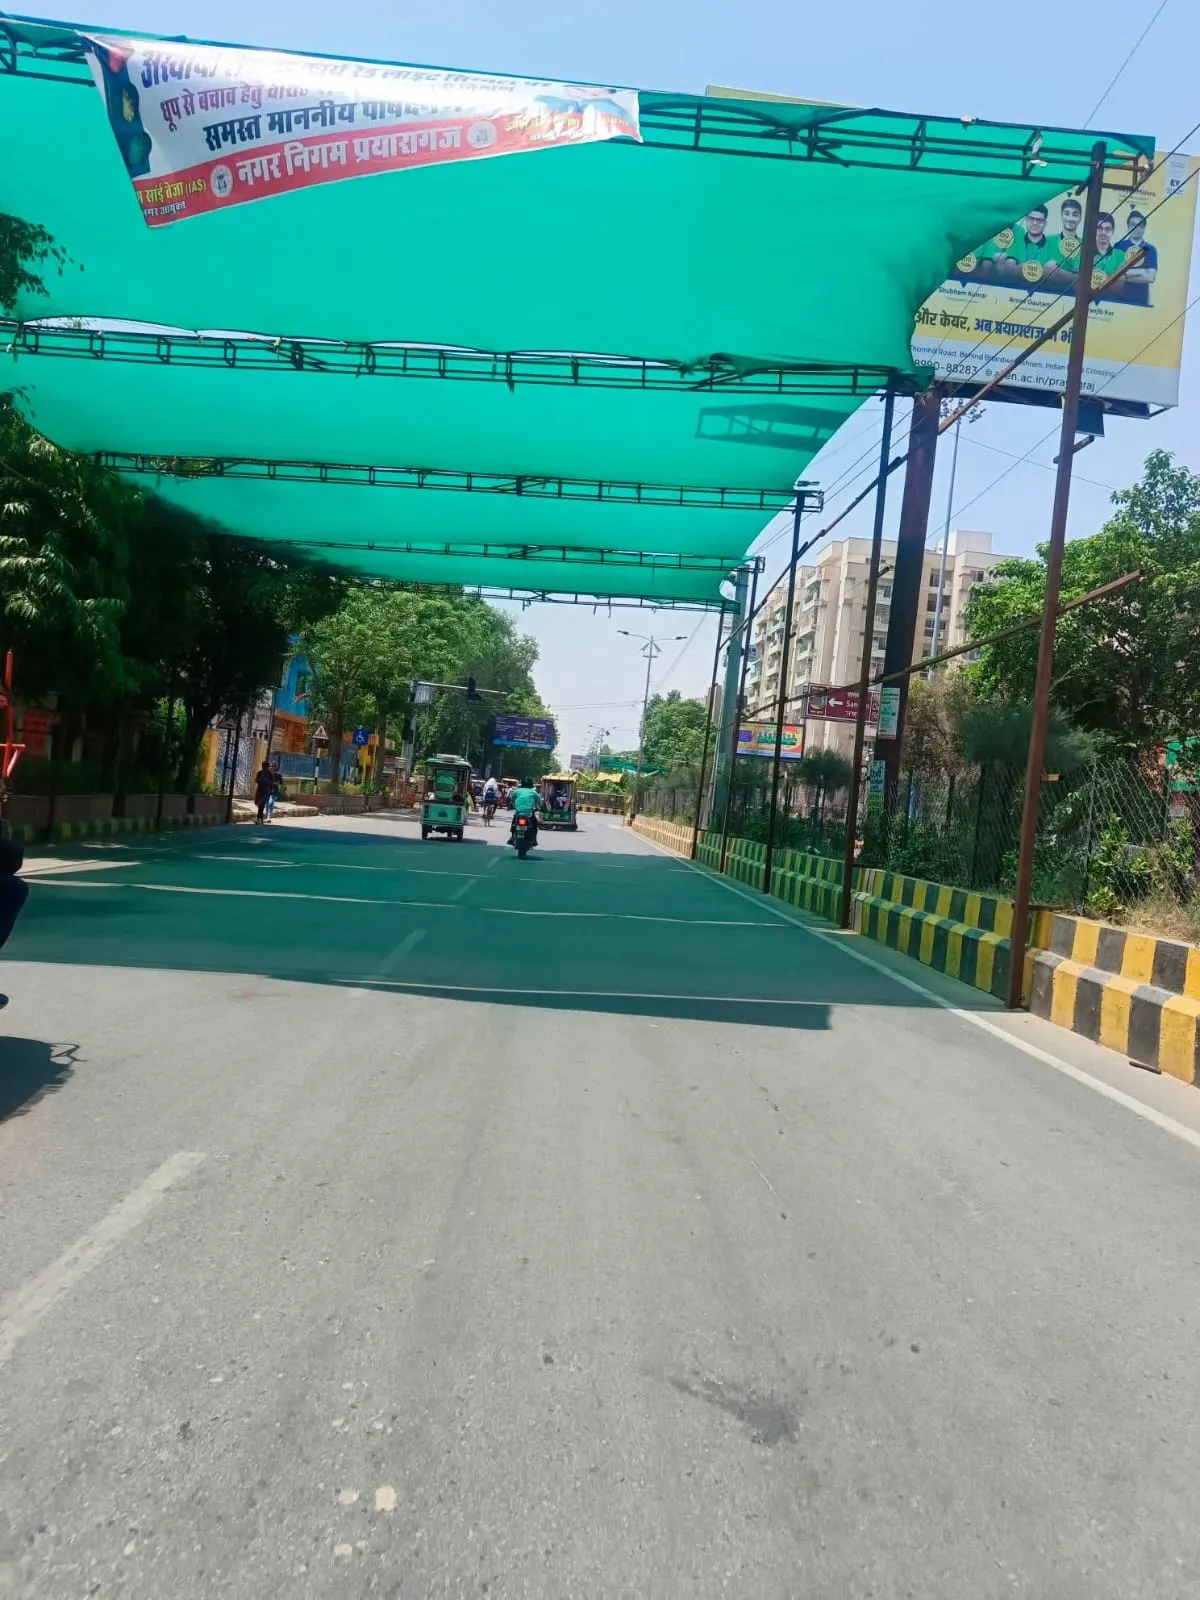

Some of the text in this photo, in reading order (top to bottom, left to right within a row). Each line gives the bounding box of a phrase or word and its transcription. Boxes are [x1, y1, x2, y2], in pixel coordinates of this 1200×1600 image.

[182, 88, 196, 116] से
[197, 86, 238, 111] बचाव
[203, 114, 262, 151] समस्त
[267, 100, 357, 134] माननीय
[236, 152, 282, 185] नगर
[284, 141, 349, 176] निगम
[185, 179, 207, 197] (IAS)
[939, 309, 970, 332] केयर,
[974, 318, 993, 333] अब
